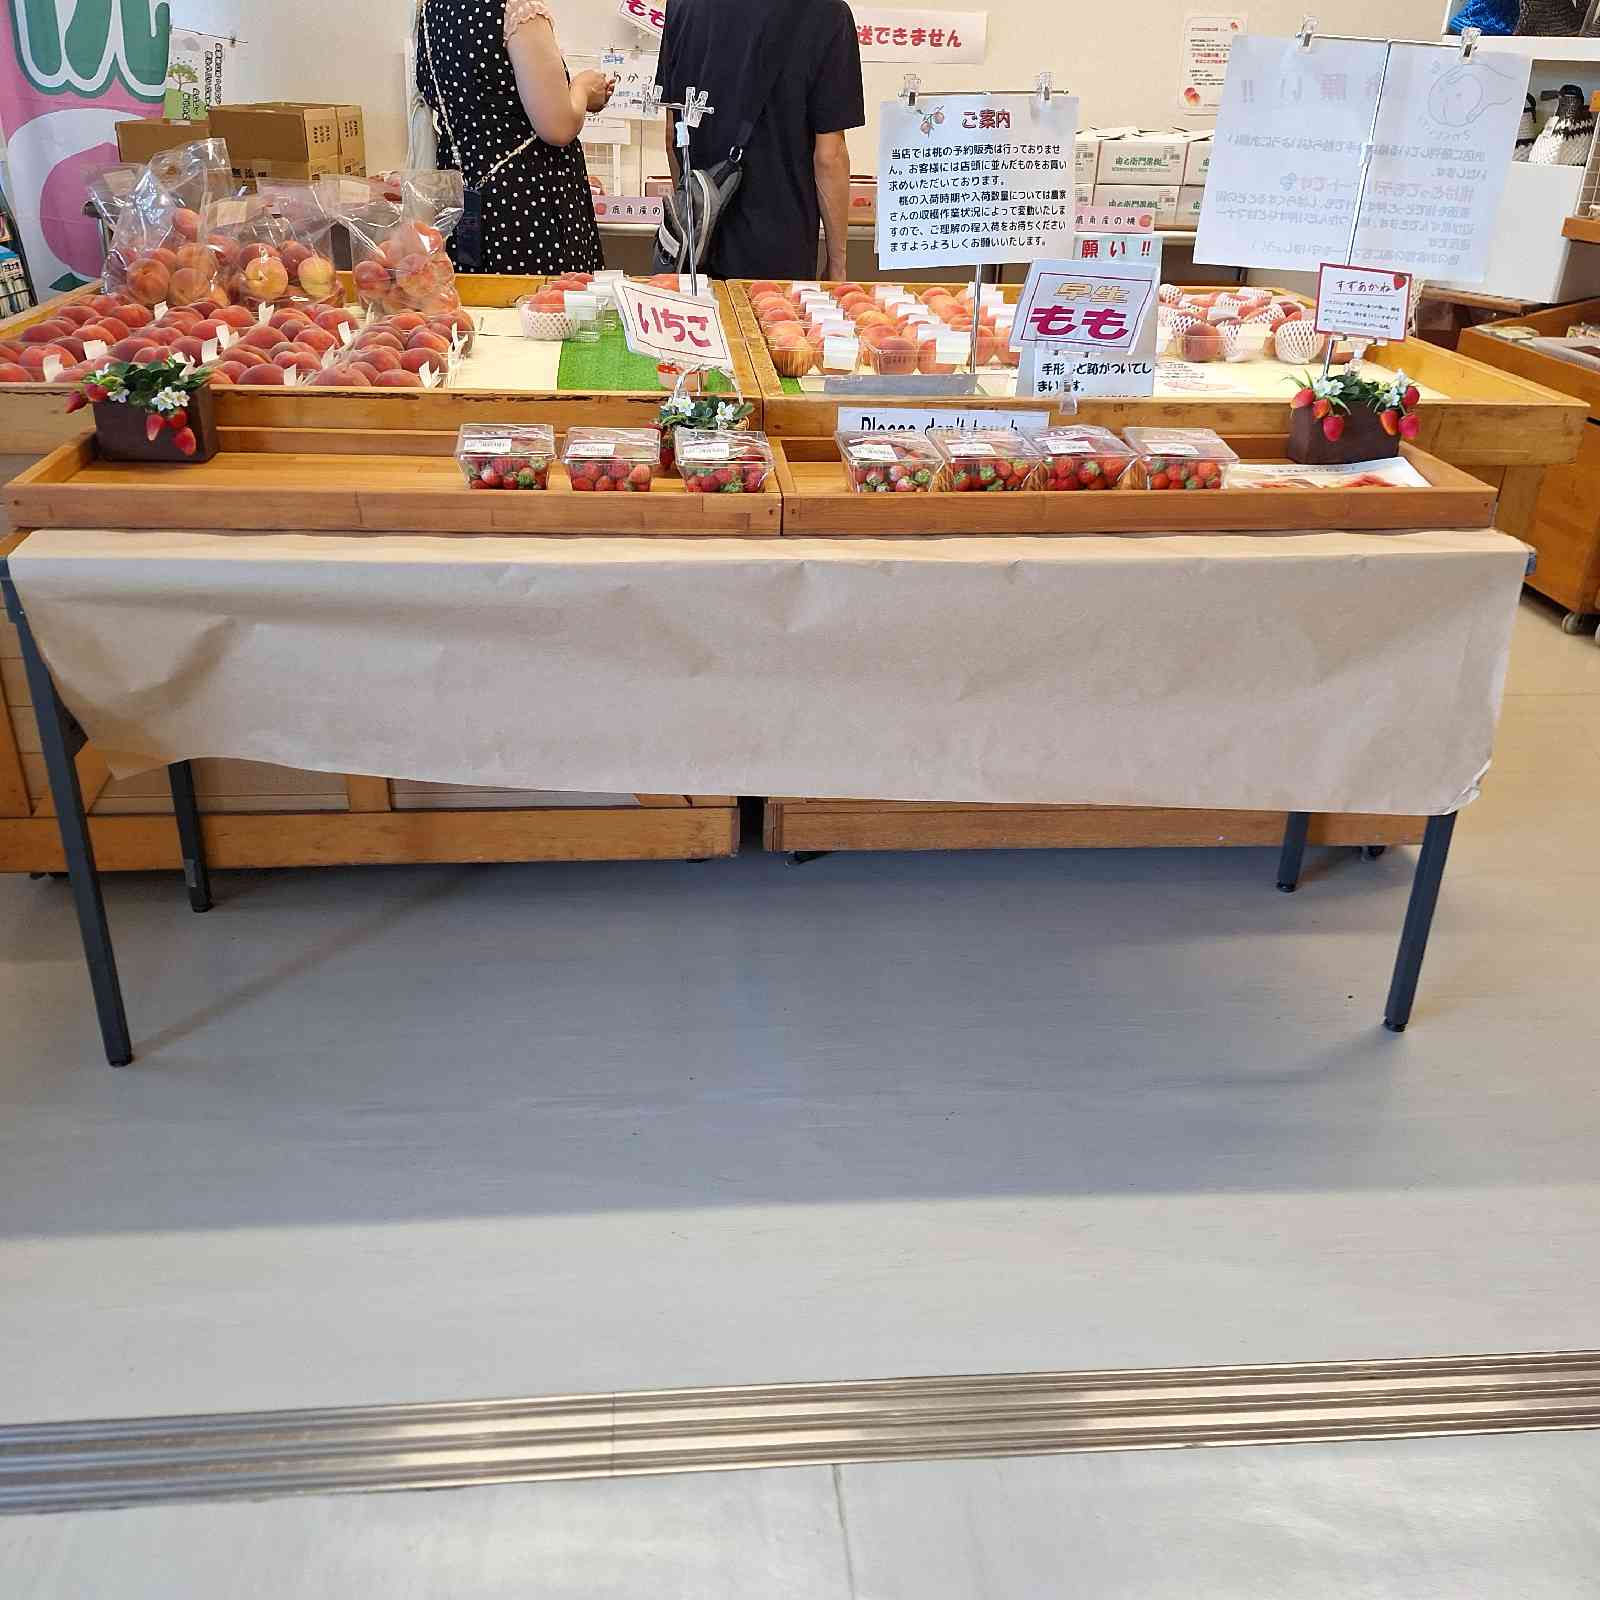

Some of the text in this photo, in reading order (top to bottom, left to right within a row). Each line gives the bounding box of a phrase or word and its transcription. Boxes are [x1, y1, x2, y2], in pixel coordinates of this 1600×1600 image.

[961, 109, 1011, 129] ご案内
[891, 143, 1060, 161] 当店では桃の予約販売は行っておりませ
[888, 159, 1067, 176] ん。お客様には店頭に並んだものをお買い
[888, 175, 1006, 192] 求めいただいております。
[898, 190, 1067, 207] 桃の入荷時期や入荷数量については農家
[889, 205, 1066, 222] さんの収穫作業状況によって変動いたしま
[889, 220, 1066, 238] すので、ご理解の程入荷をお待ちください
[889, 236, 1046, 253] ますようよろしくお願いいたします。
[1055, 281, 1131, 304] 早生
[1029, 304, 1129, 340] もも
[1041, 362, 1152, 376] 手形と跡がついてし
